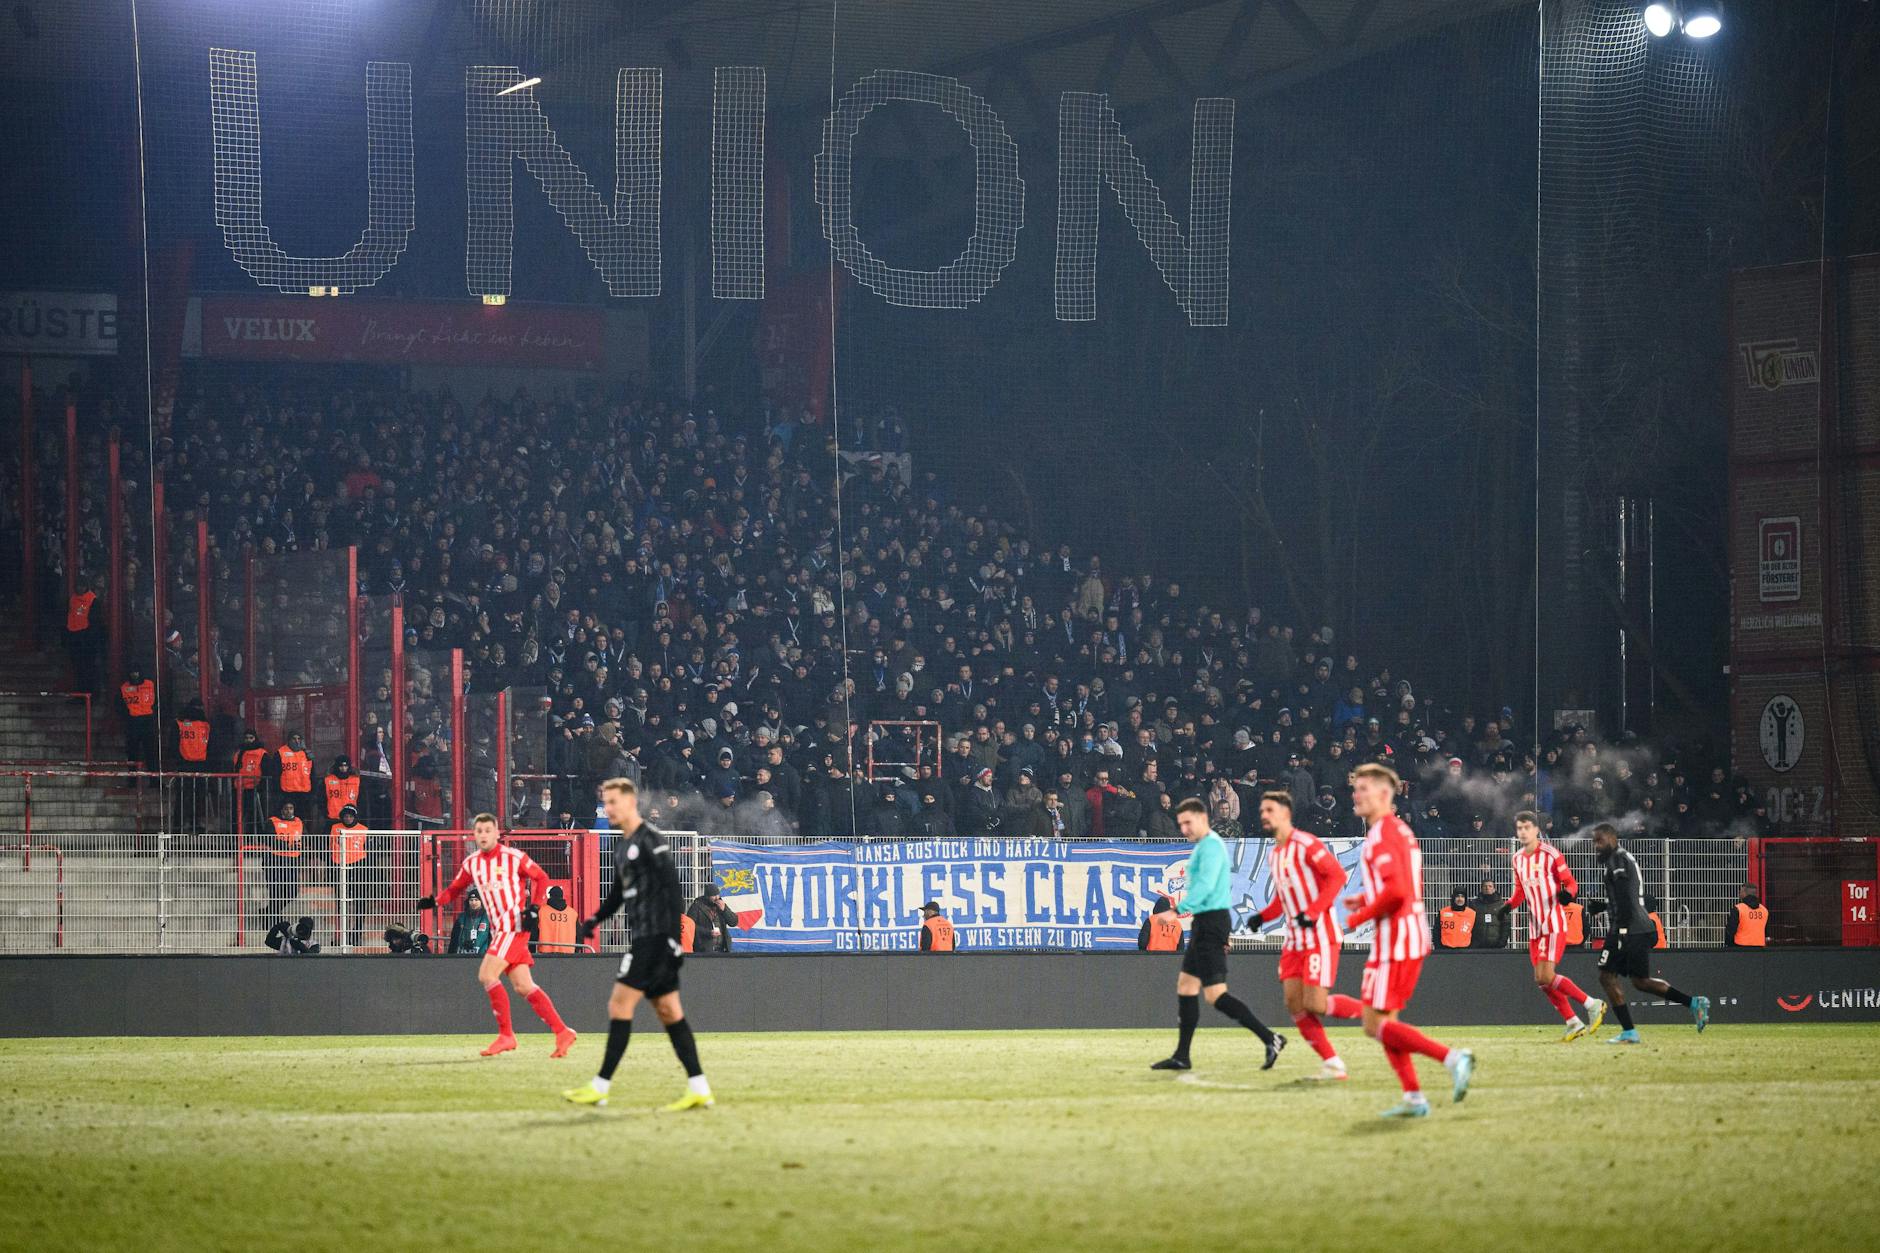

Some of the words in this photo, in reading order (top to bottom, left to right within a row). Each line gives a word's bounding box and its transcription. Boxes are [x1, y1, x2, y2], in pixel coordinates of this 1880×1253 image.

[209, 47, 1235, 327] UNION
[223, 317, 316, 343] VELUX
[856, 844, 900, 862] HANSA
[906, 840, 968, 860] ROSTOCK
[974, 841, 1000, 858] UND
[1005, 840, 1050, 858] HARTZ
[1055, 842, 1068, 859] IV
[755, 862, 1007, 928] WORKLESS
[1024, 862, 1164, 926] CLASS
[1848, 883, 1870, 900] Tor
[550, 912, 568, 923] 033
[1748, 911, 1763, 920] 038
[1850, 906, 1867, 922] 14
[966, 928, 993, 947] WIR
[1047, 929, 1065, 947] ZU
[1070, 930, 1093, 949] DIR
[1537, 937, 1547, 952] 4
[1308, 953, 1321, 973] 8
